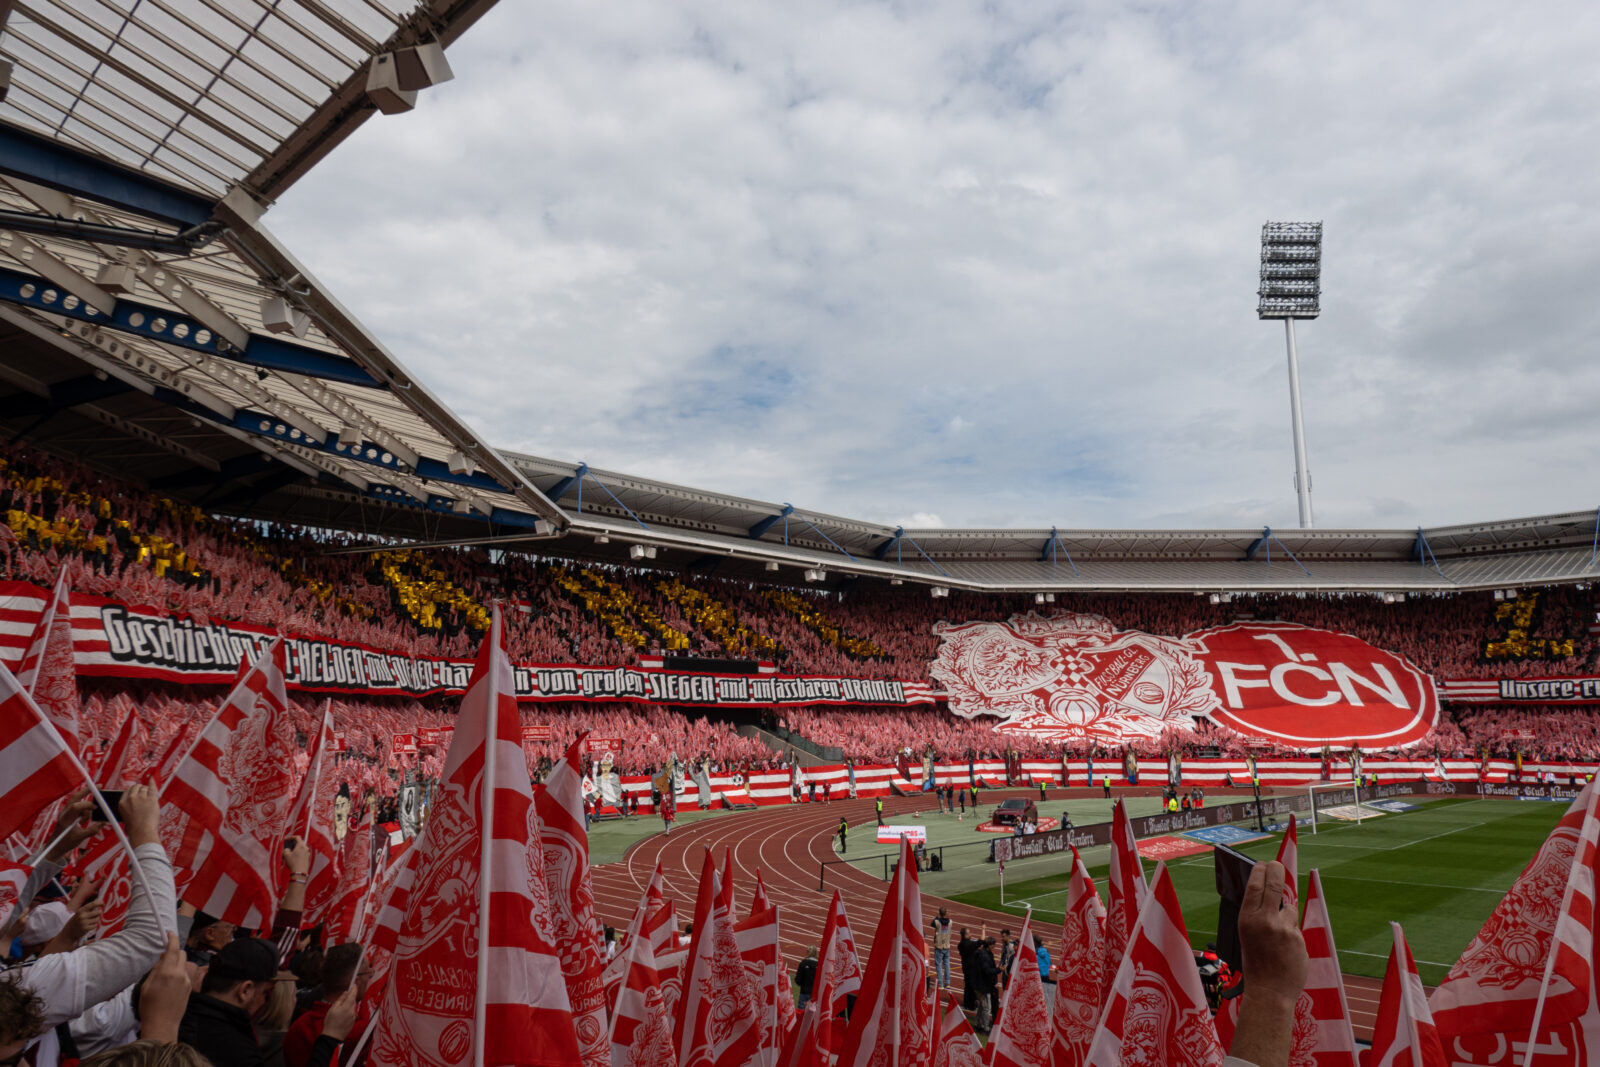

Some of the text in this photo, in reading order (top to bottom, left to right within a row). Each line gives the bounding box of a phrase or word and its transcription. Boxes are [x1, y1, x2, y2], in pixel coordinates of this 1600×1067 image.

[102, 604, 258, 671] Geschichten
[297, 638, 368, 689] HELDEN
[366, 652, 396, 686] und
[537, 669, 577, 695] von
[582, 667, 645, 697] großen
[649, 673, 718, 704] SIEGEN
[718, 677, 749, 701] und
[752, 677, 842, 702] unfassbaren
[841, 678, 907, 704] DRAMEN
[1252, 633, 1318, 662] 1.
[1106, 655, 1150, 696] NÜRNBERG
[1215, 661, 1411, 710] FCN
[1499, 679, 1575, 699] Unsere
